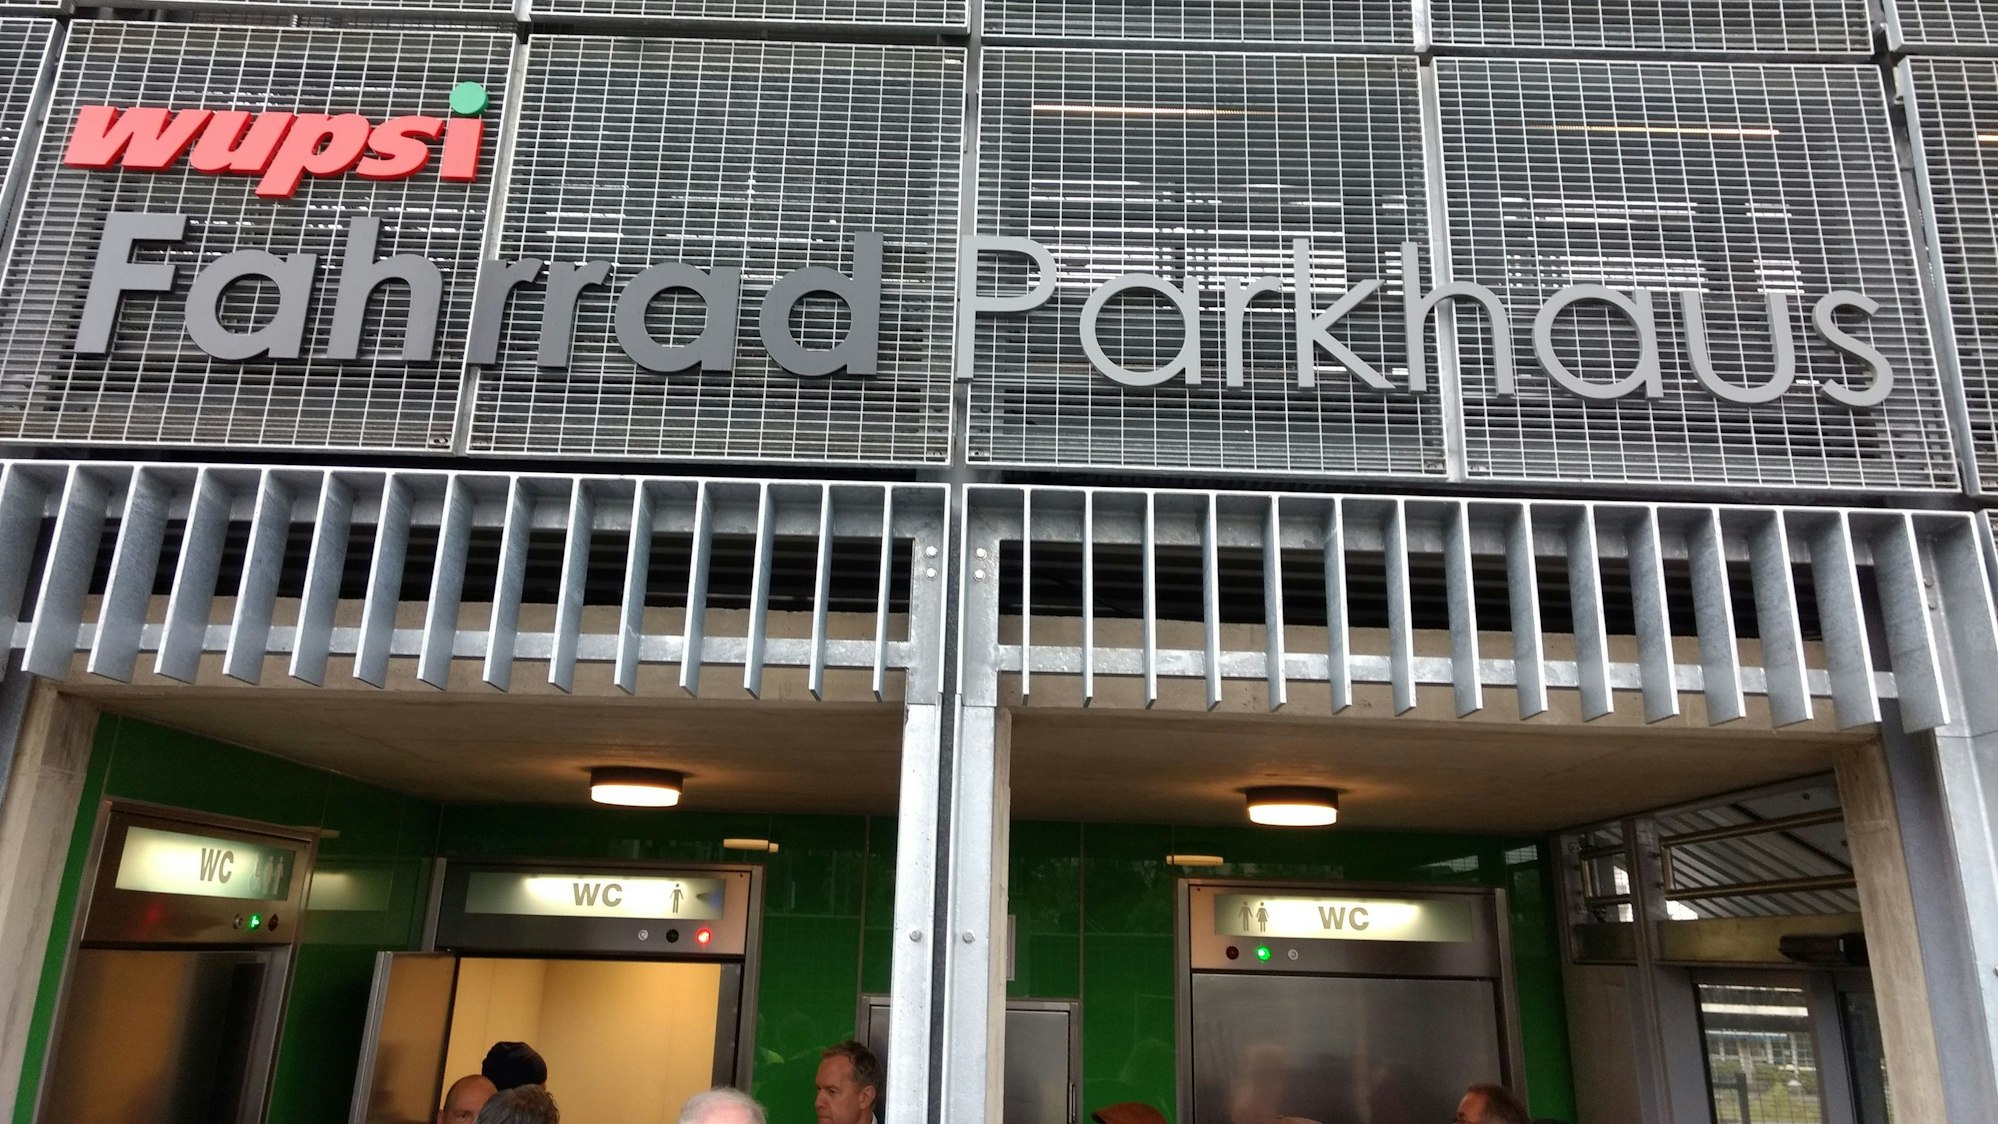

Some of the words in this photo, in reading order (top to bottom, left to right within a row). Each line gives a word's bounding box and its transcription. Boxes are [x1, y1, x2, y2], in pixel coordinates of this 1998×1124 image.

[64, 81, 490, 199] wupsi
[74, 211, 885, 378] Fahrrad
[956, 234, 1894, 408] Parkhaus
[199, 847, 235, 884] WC
[572, 882, 623, 907] WC
[1318, 905, 1370, 931] WC
